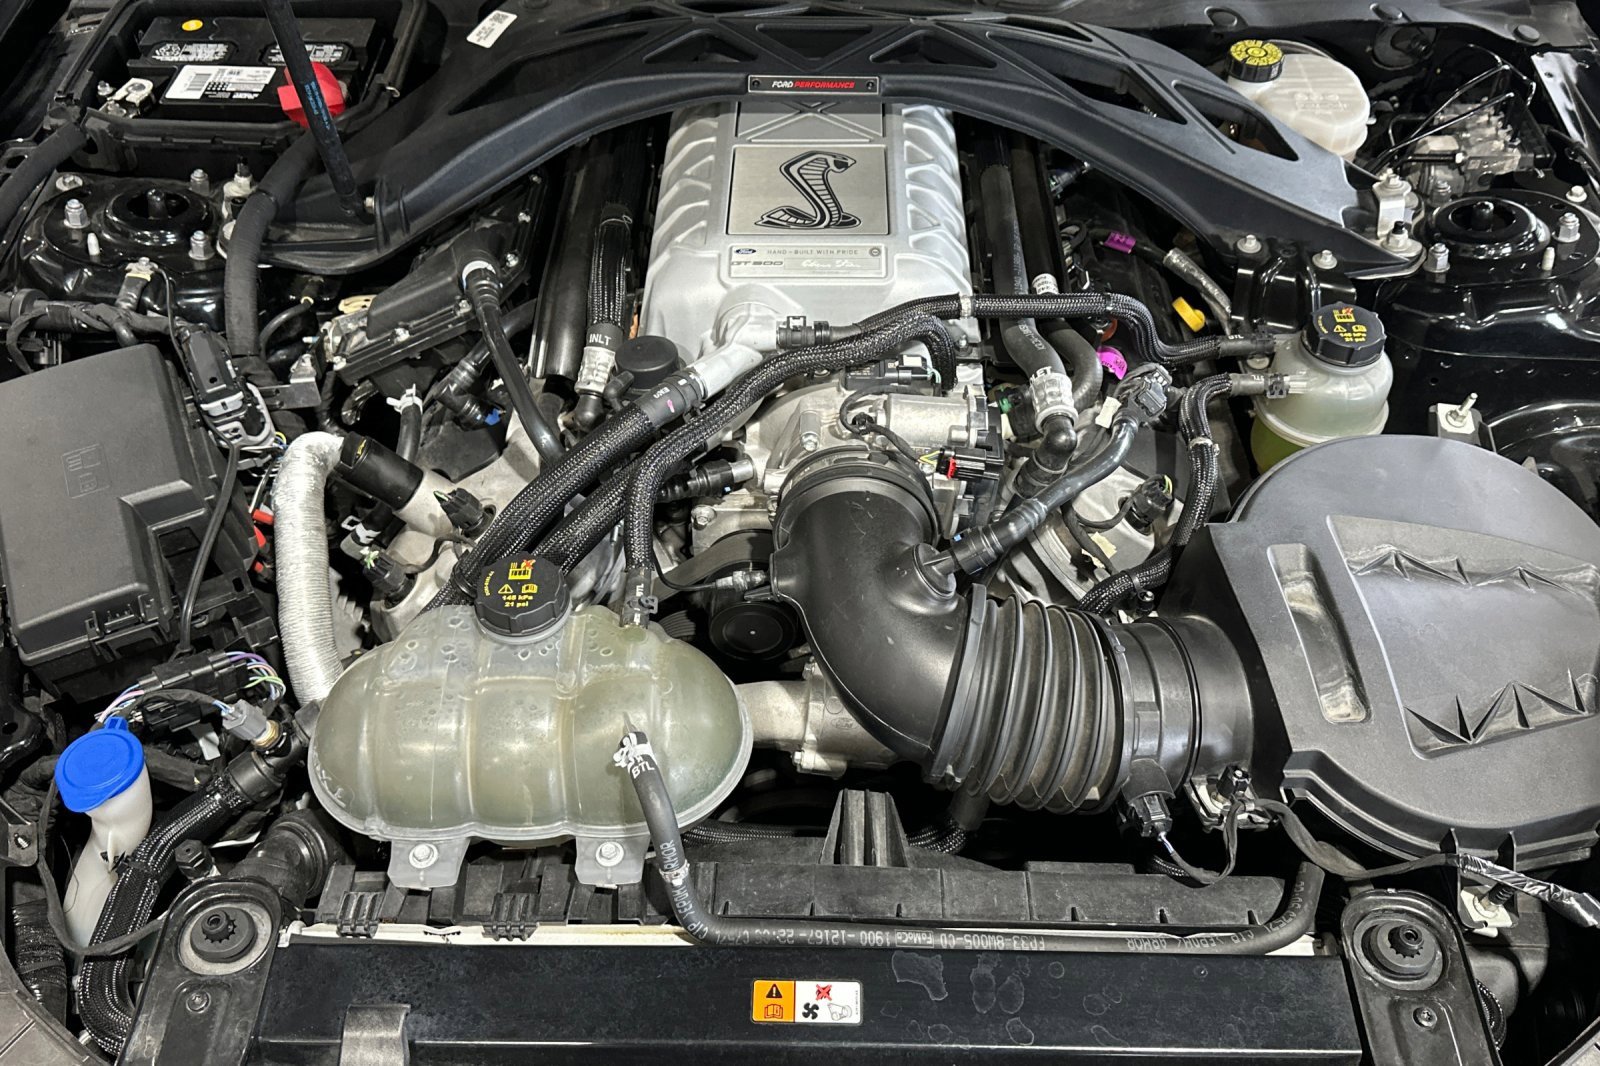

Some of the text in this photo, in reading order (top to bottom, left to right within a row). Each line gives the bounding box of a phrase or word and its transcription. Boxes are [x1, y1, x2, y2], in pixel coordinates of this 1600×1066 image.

[771, 80, 855, 89] FORD PERFORMANCE
[735, 247, 757, 255] Ford
[589, 333, 612, 346] INLT
[631, 760, 655, 779] BTL
[859, 930, 891, 946] 1900
[895, 931, 934, 944] FoMoCo
